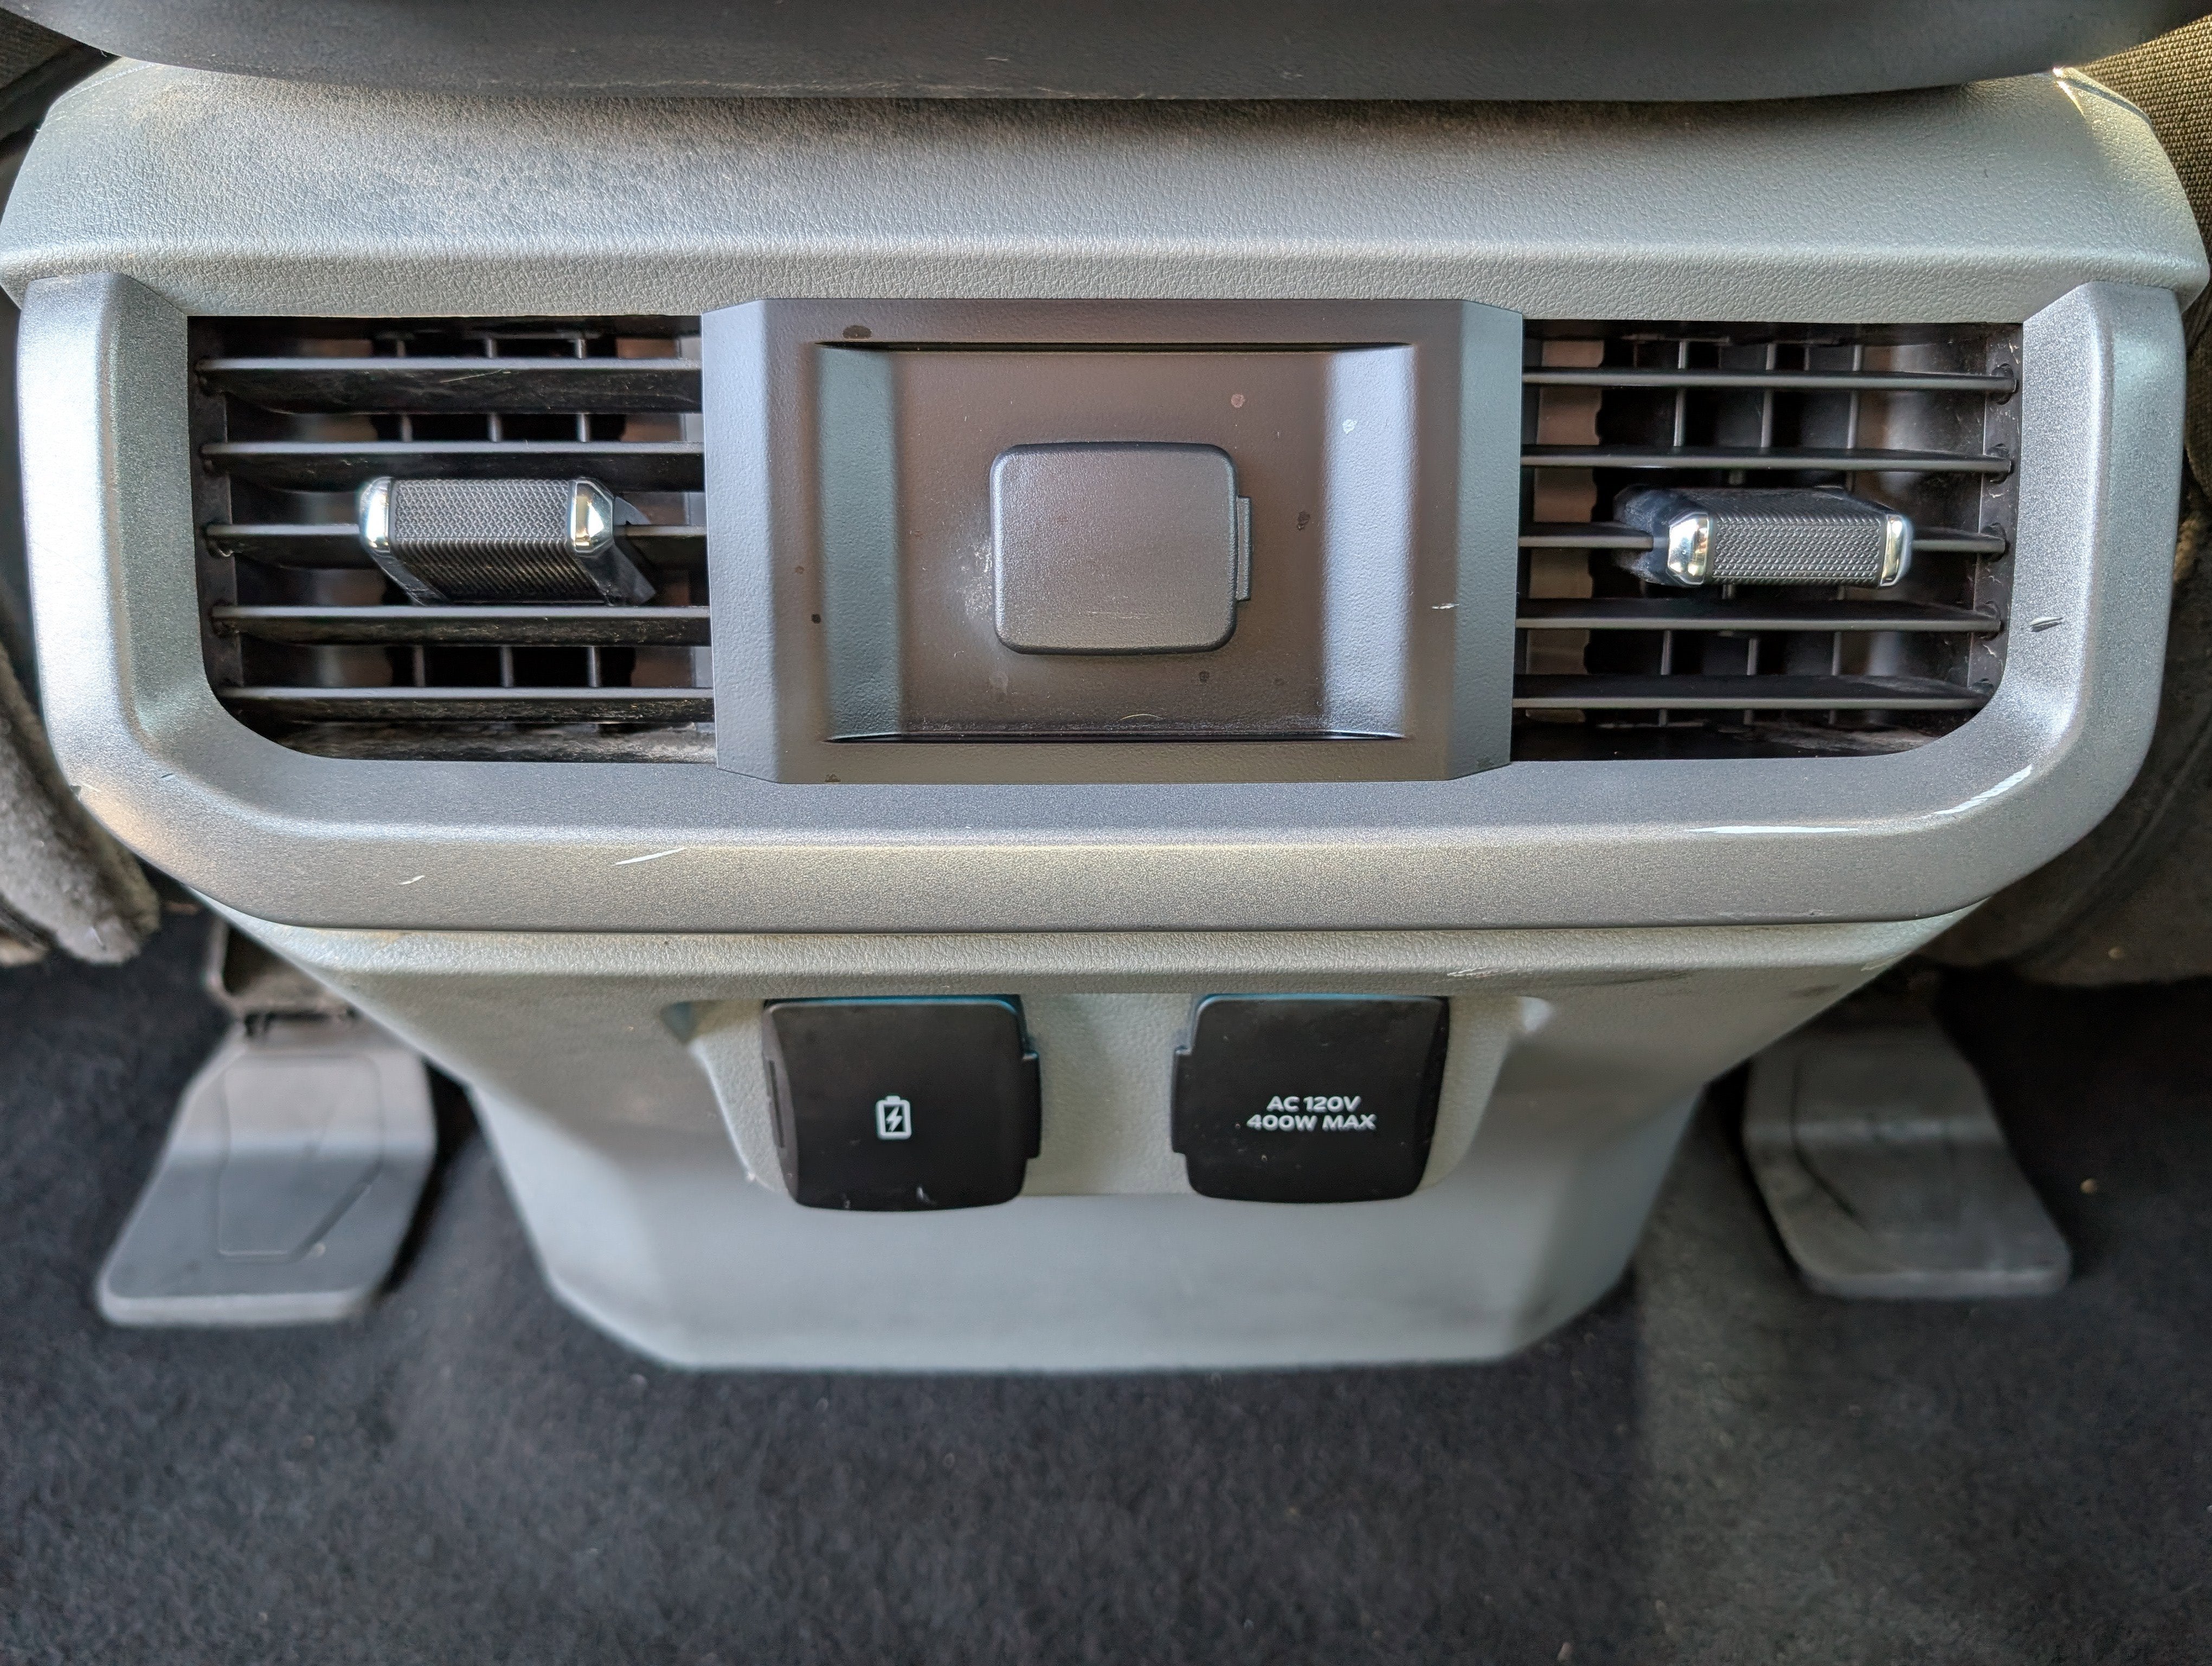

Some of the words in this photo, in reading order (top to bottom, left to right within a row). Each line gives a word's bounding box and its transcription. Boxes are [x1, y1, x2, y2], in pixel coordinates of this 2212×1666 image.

[1266, 1095, 1300, 1112] AC
[1303, 1095, 1361, 1112] 120V
[1246, 1114, 1317, 1131] 400W
[1322, 1114, 1377, 1130] MAX
